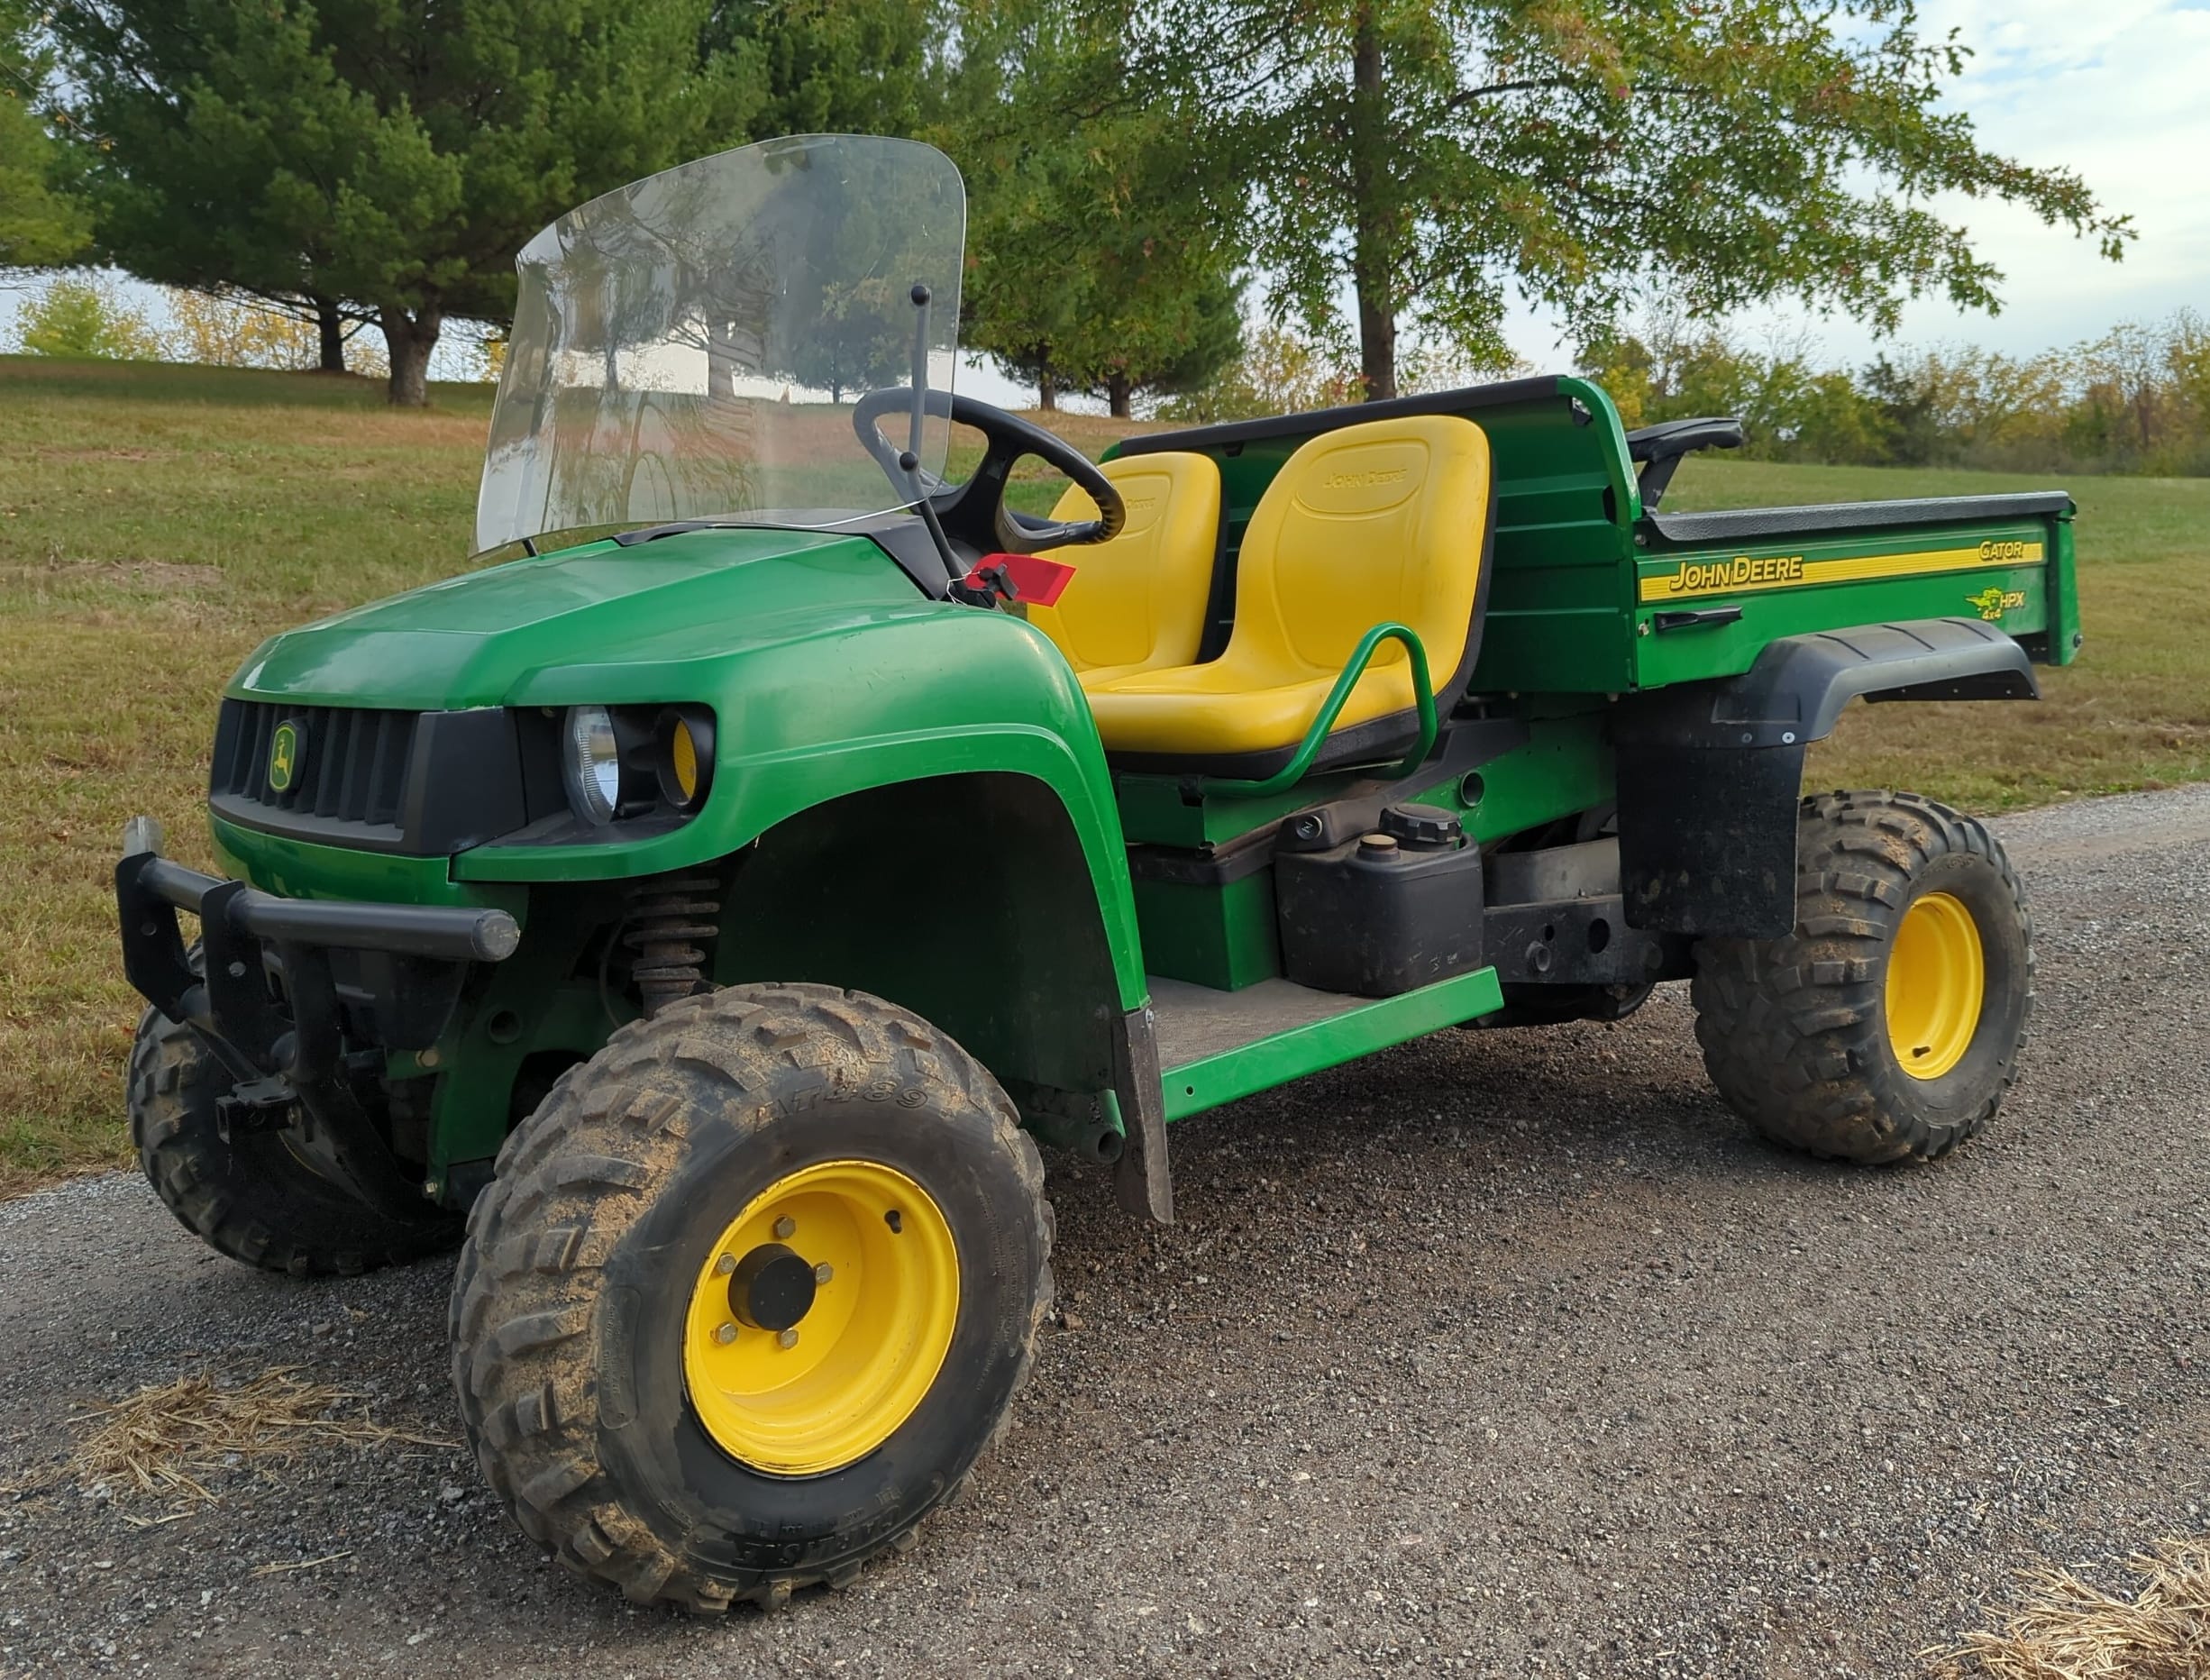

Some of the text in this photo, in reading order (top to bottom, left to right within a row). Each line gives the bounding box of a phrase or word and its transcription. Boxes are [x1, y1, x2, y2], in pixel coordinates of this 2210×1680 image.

[1979, 541, 2023, 560] GATOR
[1669, 556, 1804, 590] JOHN DEERE
[2000, 591, 2025, 608] HPX
